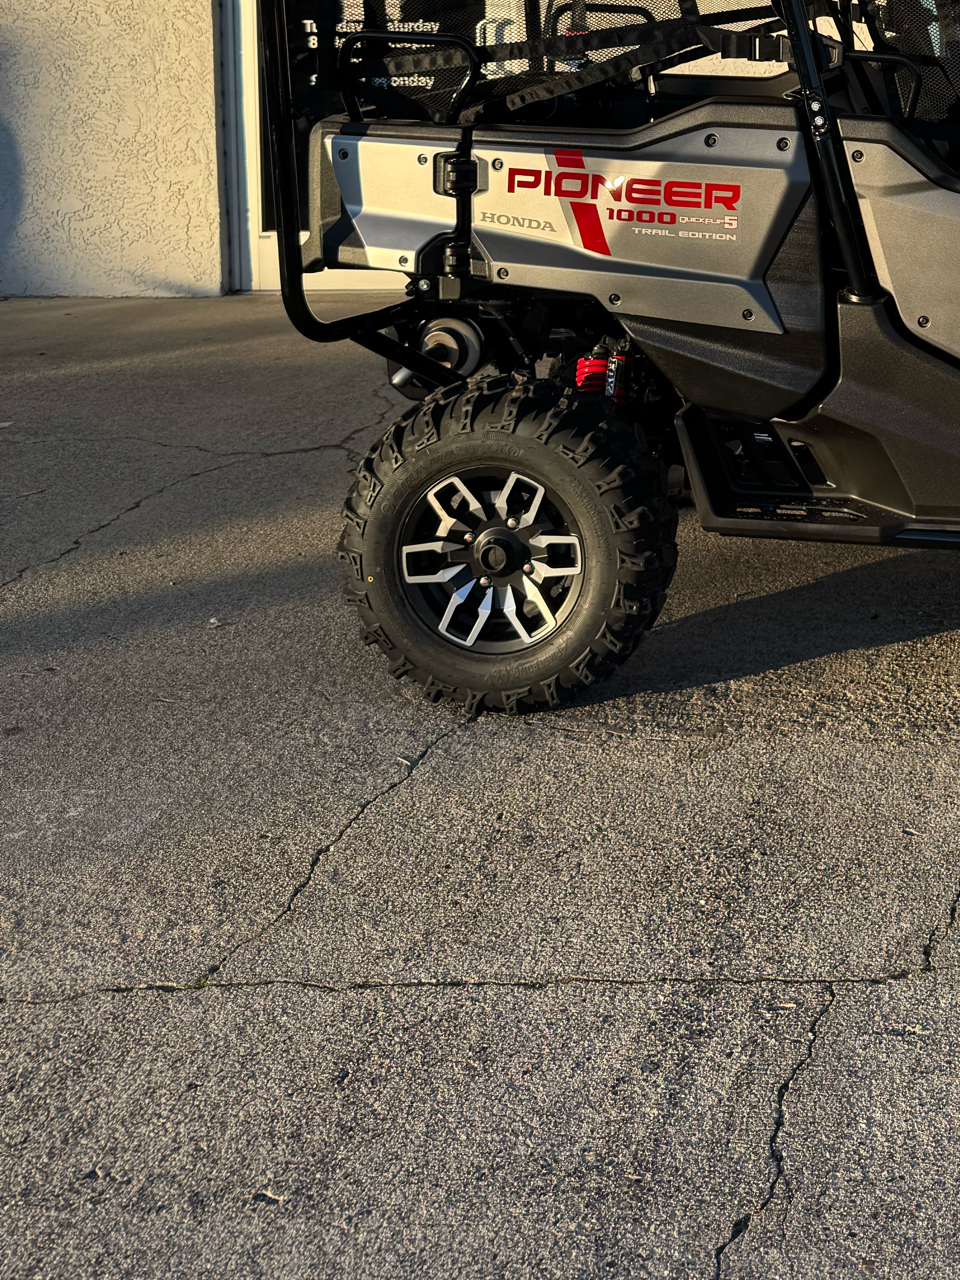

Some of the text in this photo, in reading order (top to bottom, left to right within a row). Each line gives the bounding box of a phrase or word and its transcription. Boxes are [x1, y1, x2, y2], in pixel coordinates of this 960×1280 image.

[507, 167, 741, 211] PIONEER
[480, 211, 557, 233] HONDA
[605, 207, 677, 225] 1000
[632, 227, 737, 241] TRAIL EDITION
